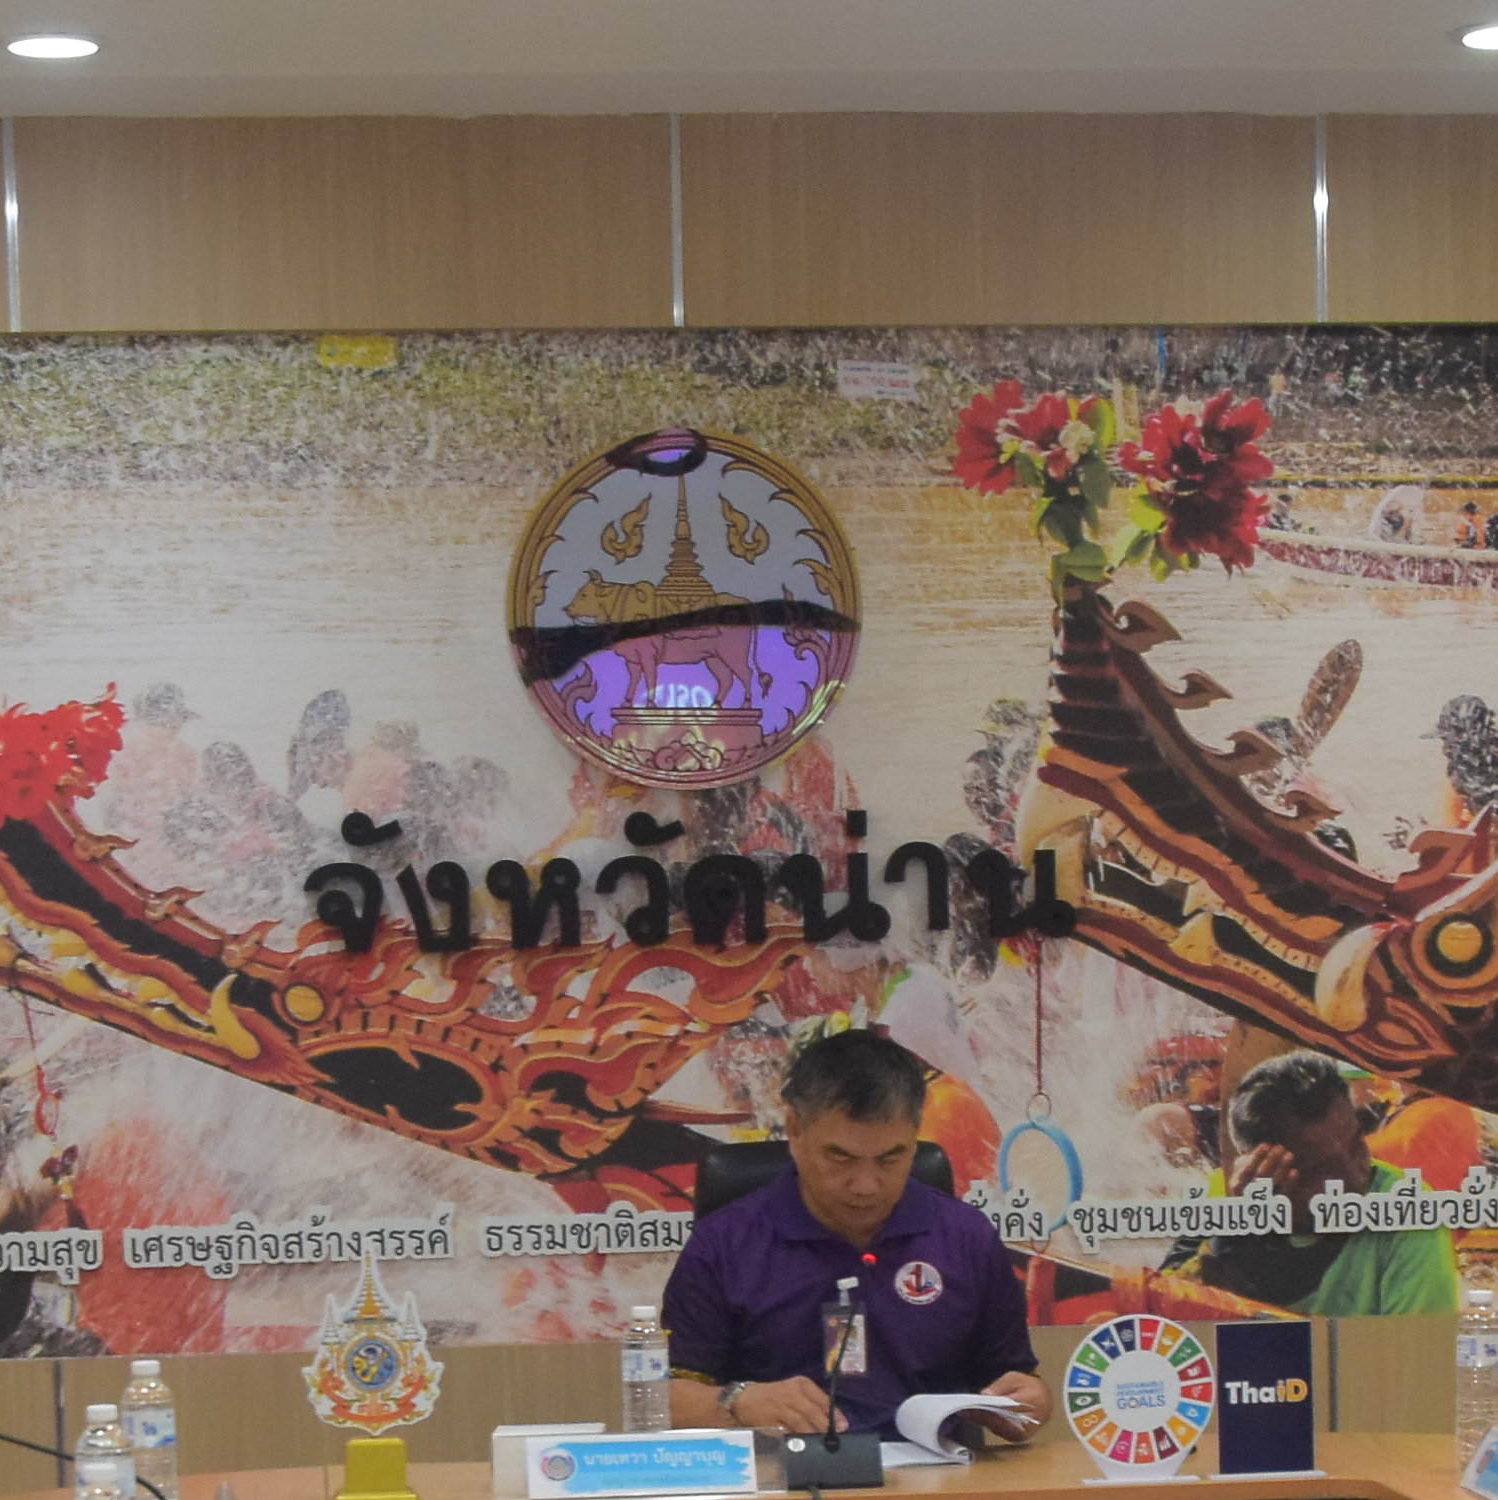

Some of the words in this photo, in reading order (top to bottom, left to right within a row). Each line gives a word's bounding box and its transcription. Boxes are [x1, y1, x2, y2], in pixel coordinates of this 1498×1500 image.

[304, 810, 1076, 952] จังหวัดน่าน
[130, 1213, 449, 1275] เศรษฐกิจสร้างสรรค์
[1073, 1187, 1287, 1248] ชุมชนเข้มแข็ง
[1116, 1394, 1166, 1410] GOALS
[1224, 1378, 1308, 1405] ThaiD
